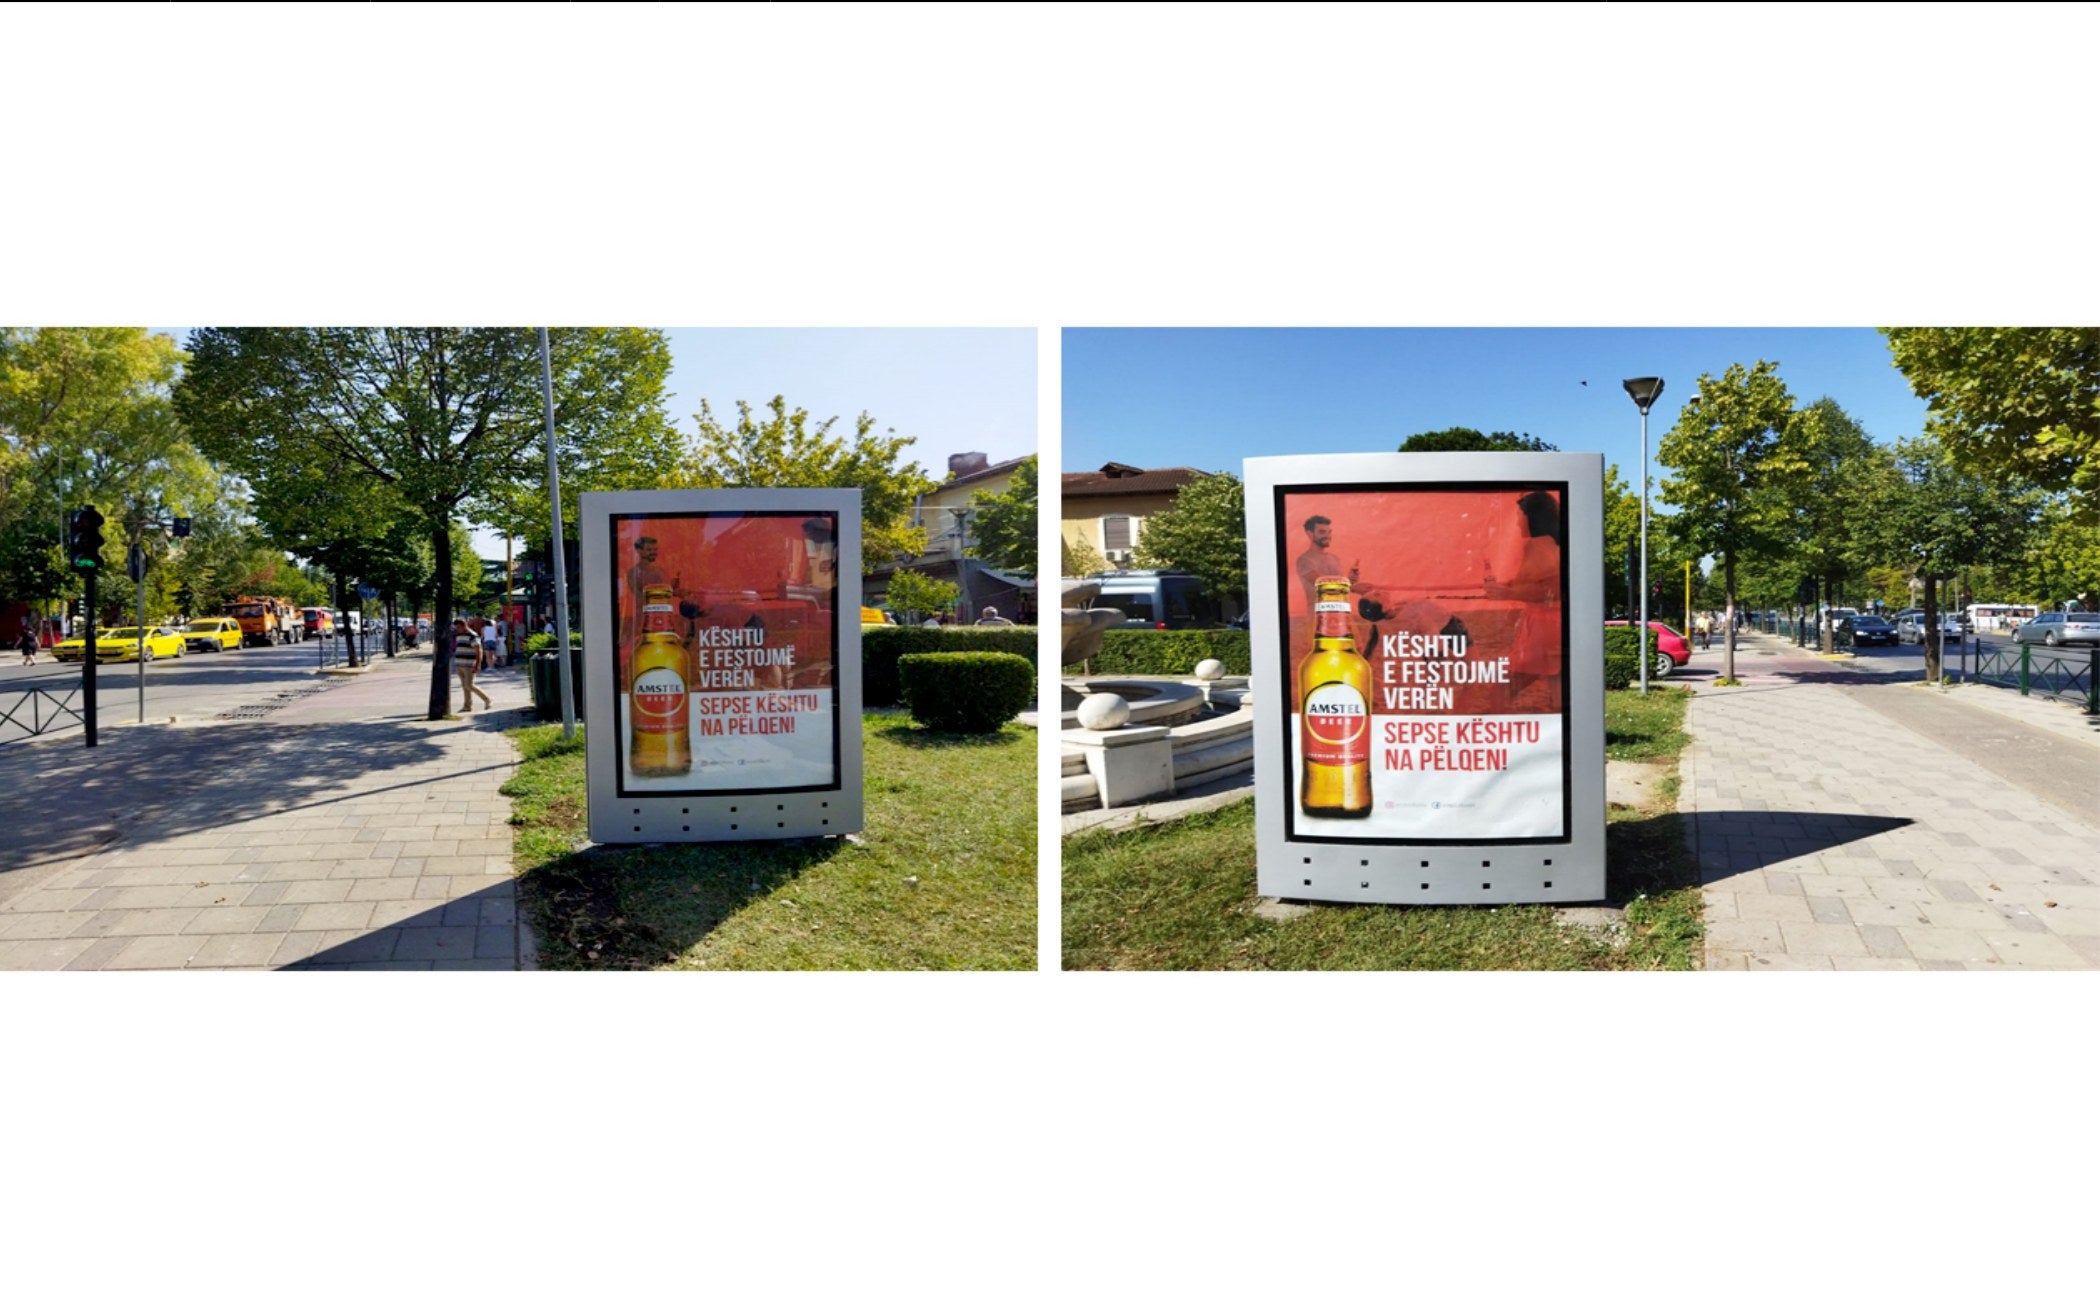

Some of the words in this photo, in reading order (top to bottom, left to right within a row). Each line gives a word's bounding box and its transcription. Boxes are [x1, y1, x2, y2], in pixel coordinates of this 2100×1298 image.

[699, 626, 764, 647] KËSHTU
[1383, 631, 1467, 658] KËSHTU
[700, 649, 710, 667] E
[714, 644, 796, 667] FESTOJMË
[699, 666, 755, 688] VERËN
[1384, 661, 1396, 684] E
[1402, 657, 1511, 684] FESTOJMË
[637, 684, 681, 693] AMSTEL
[1384, 683, 1454, 710] VERËN
[700, 696, 752, 715] SEPSE
[756, 693, 818, 713] KËSHTU
[1309, 703, 1361, 714] AMSTEL
[701, 718, 723, 736] NA
[728, 714, 796, 736] PËLQEN!
[1384, 722, 1449, 744] SEPSE
[1456, 718, 1540, 744] KËSHTU
[1385, 749, 1413, 770] NA
[1420, 745, 1508, 771] PËLQEN!
